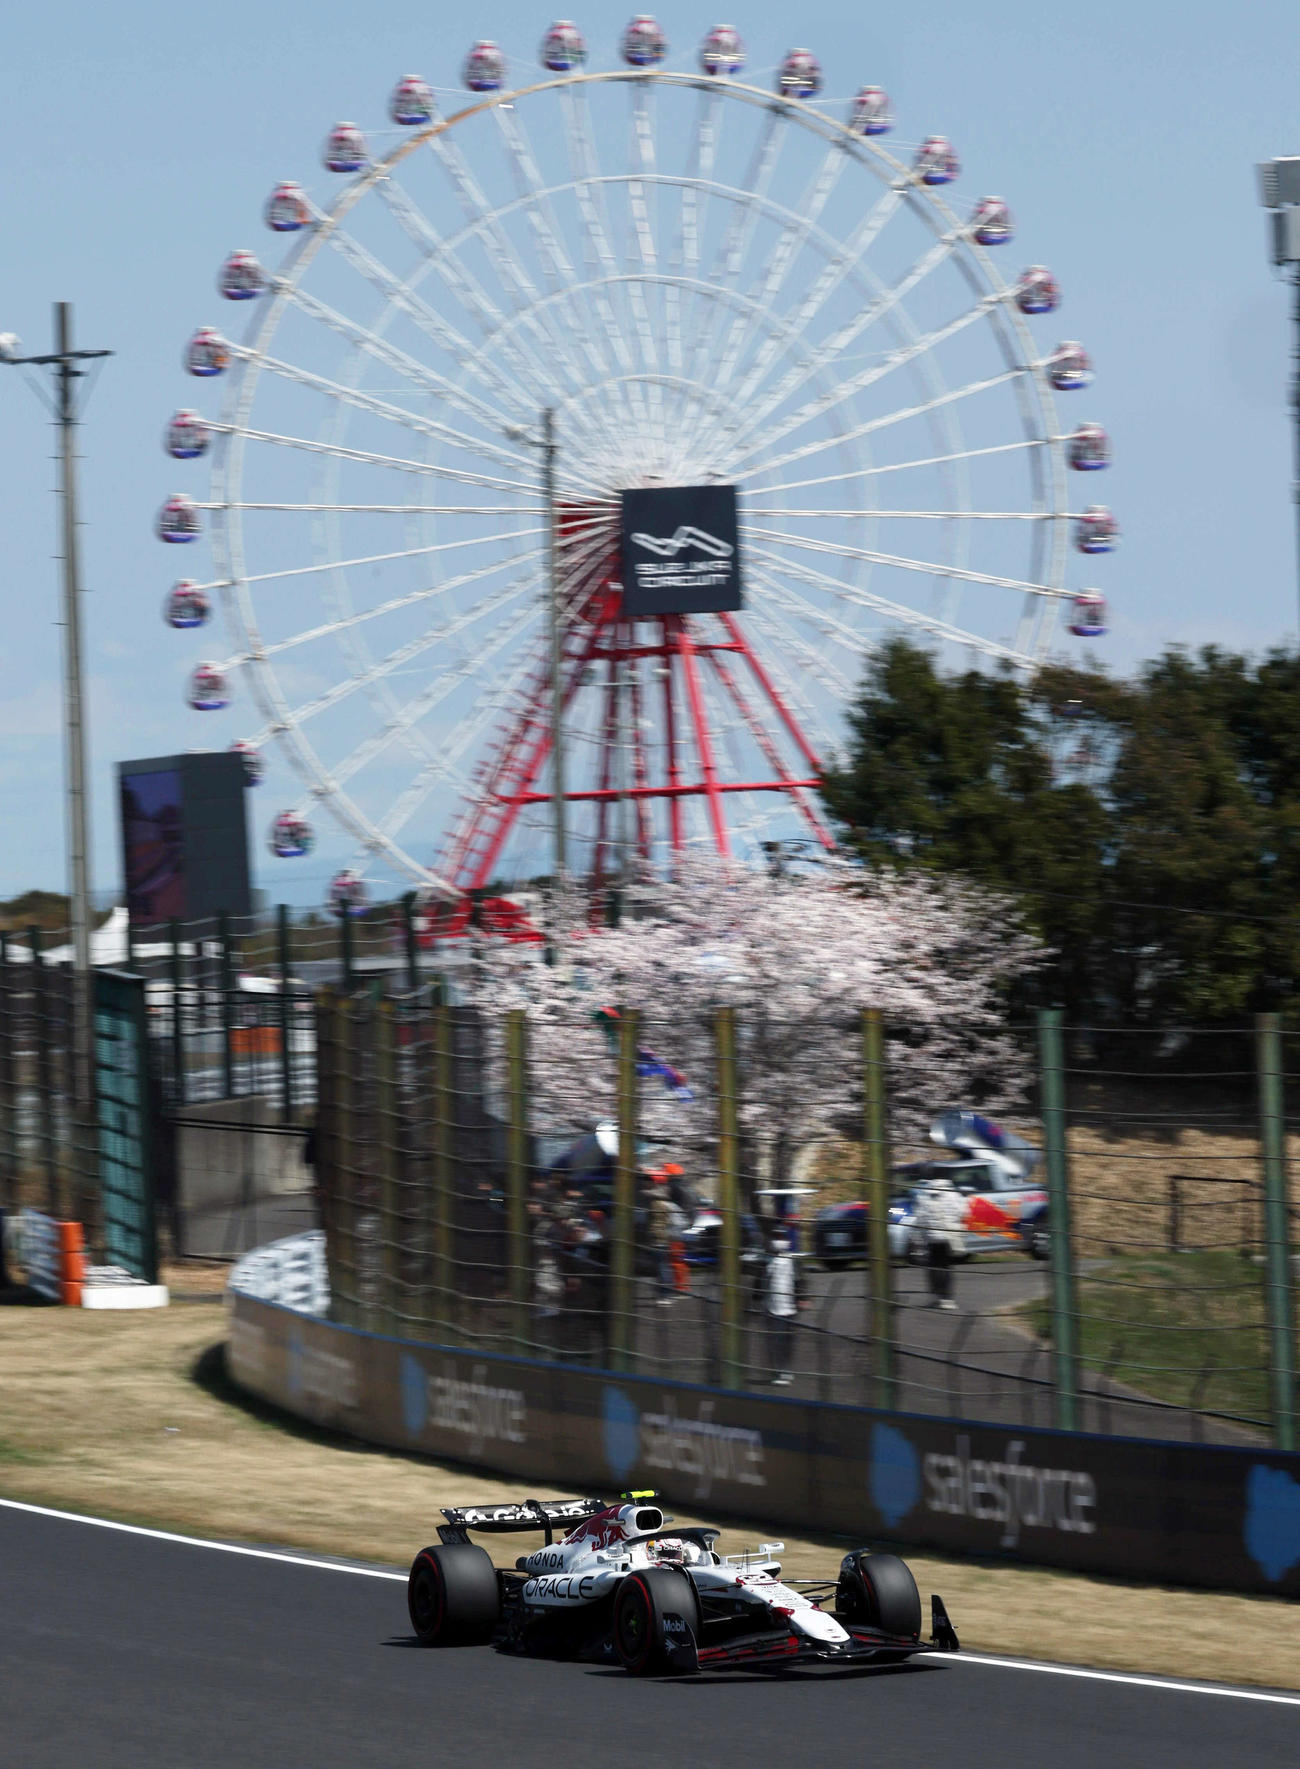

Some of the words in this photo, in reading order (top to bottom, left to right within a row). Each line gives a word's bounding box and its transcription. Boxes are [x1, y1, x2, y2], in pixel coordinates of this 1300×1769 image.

[923, 1434, 1097, 1548] salesforce
[528, 1552, 564, 1569] HONDA
[525, 1575, 598, 1600] ORACLE
[662, 1619, 686, 1632] Mobil
